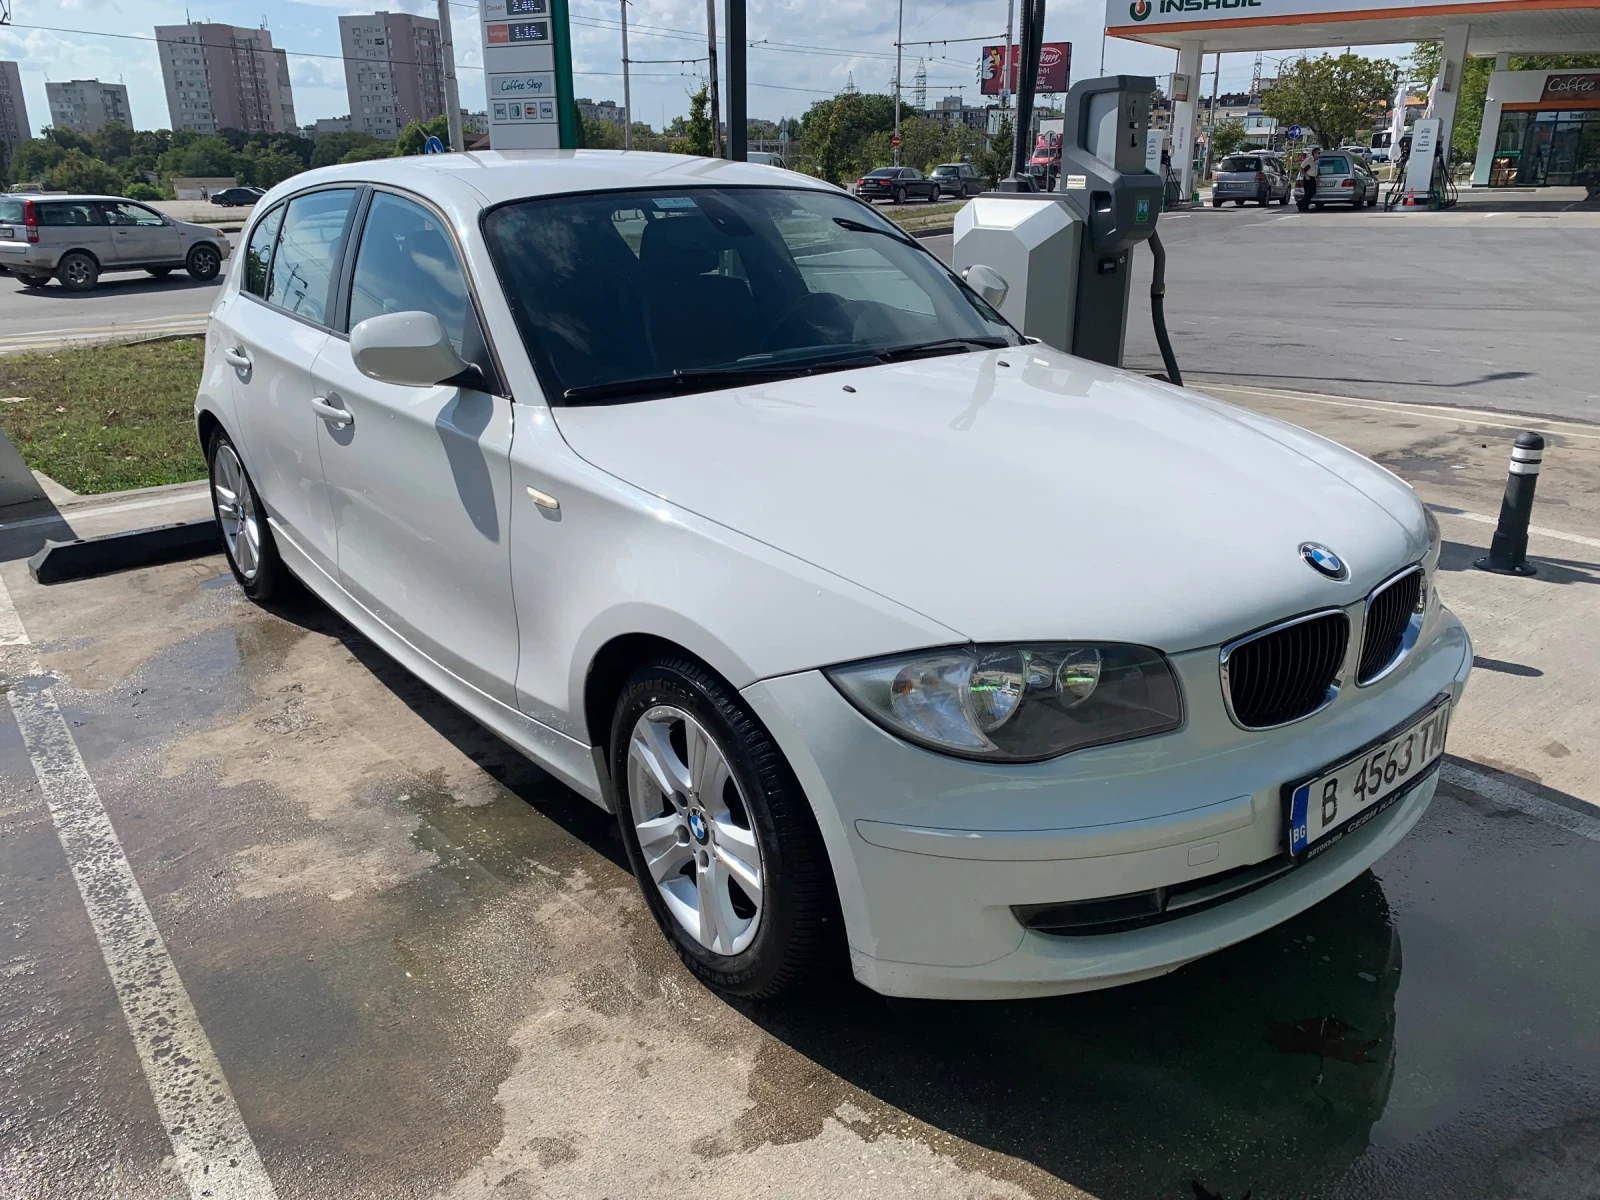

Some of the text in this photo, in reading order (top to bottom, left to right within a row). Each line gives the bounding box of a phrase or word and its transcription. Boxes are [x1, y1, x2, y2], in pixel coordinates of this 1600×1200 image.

[501, 78, 543, 93] Coffee Shop
[1548, 76, 1595, 91] Coffee
[1321, 777, 1338, 828] B
[1353, 733, 1414, 802] 4563
[1293, 824, 1306, 843] BG
